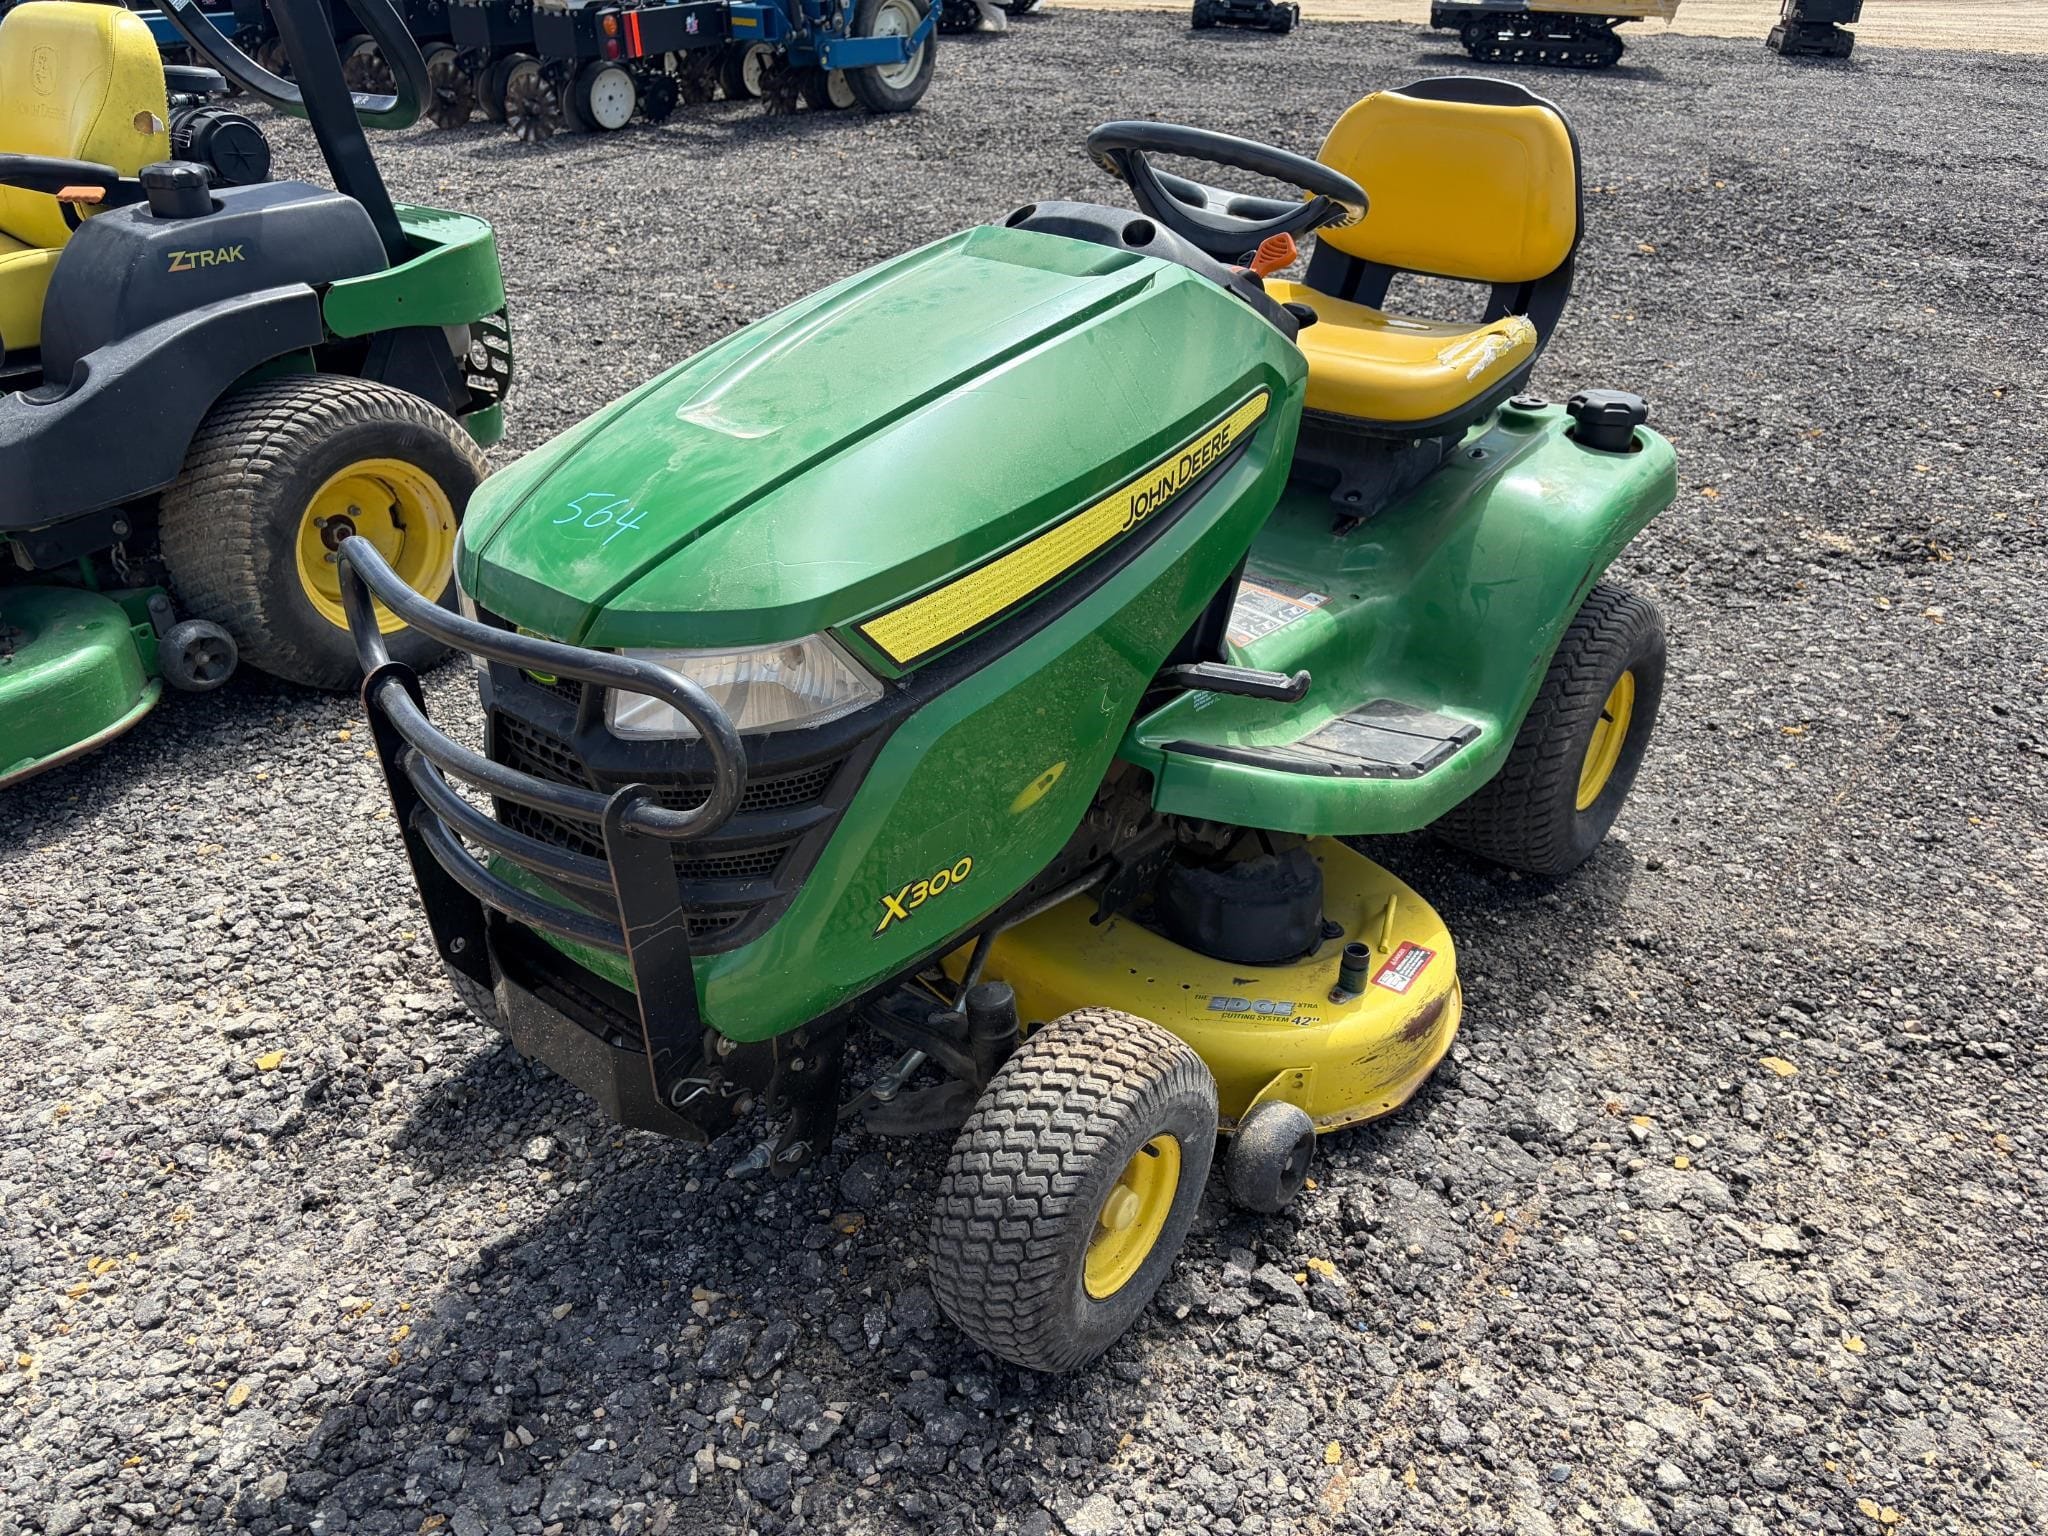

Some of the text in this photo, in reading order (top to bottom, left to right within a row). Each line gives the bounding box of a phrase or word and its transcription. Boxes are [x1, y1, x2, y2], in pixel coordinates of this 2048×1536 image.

[167, 244, 246, 273] ZTRAK
[1122, 423, 1232, 529] JOHN DEERE
[552, 491, 649, 546] 564
[873, 855, 974, 937] X300
[1206, 996, 1295, 1017] EDGE
[1220, 1011, 1322, 1027] CUTTING SYSTEM 42"
